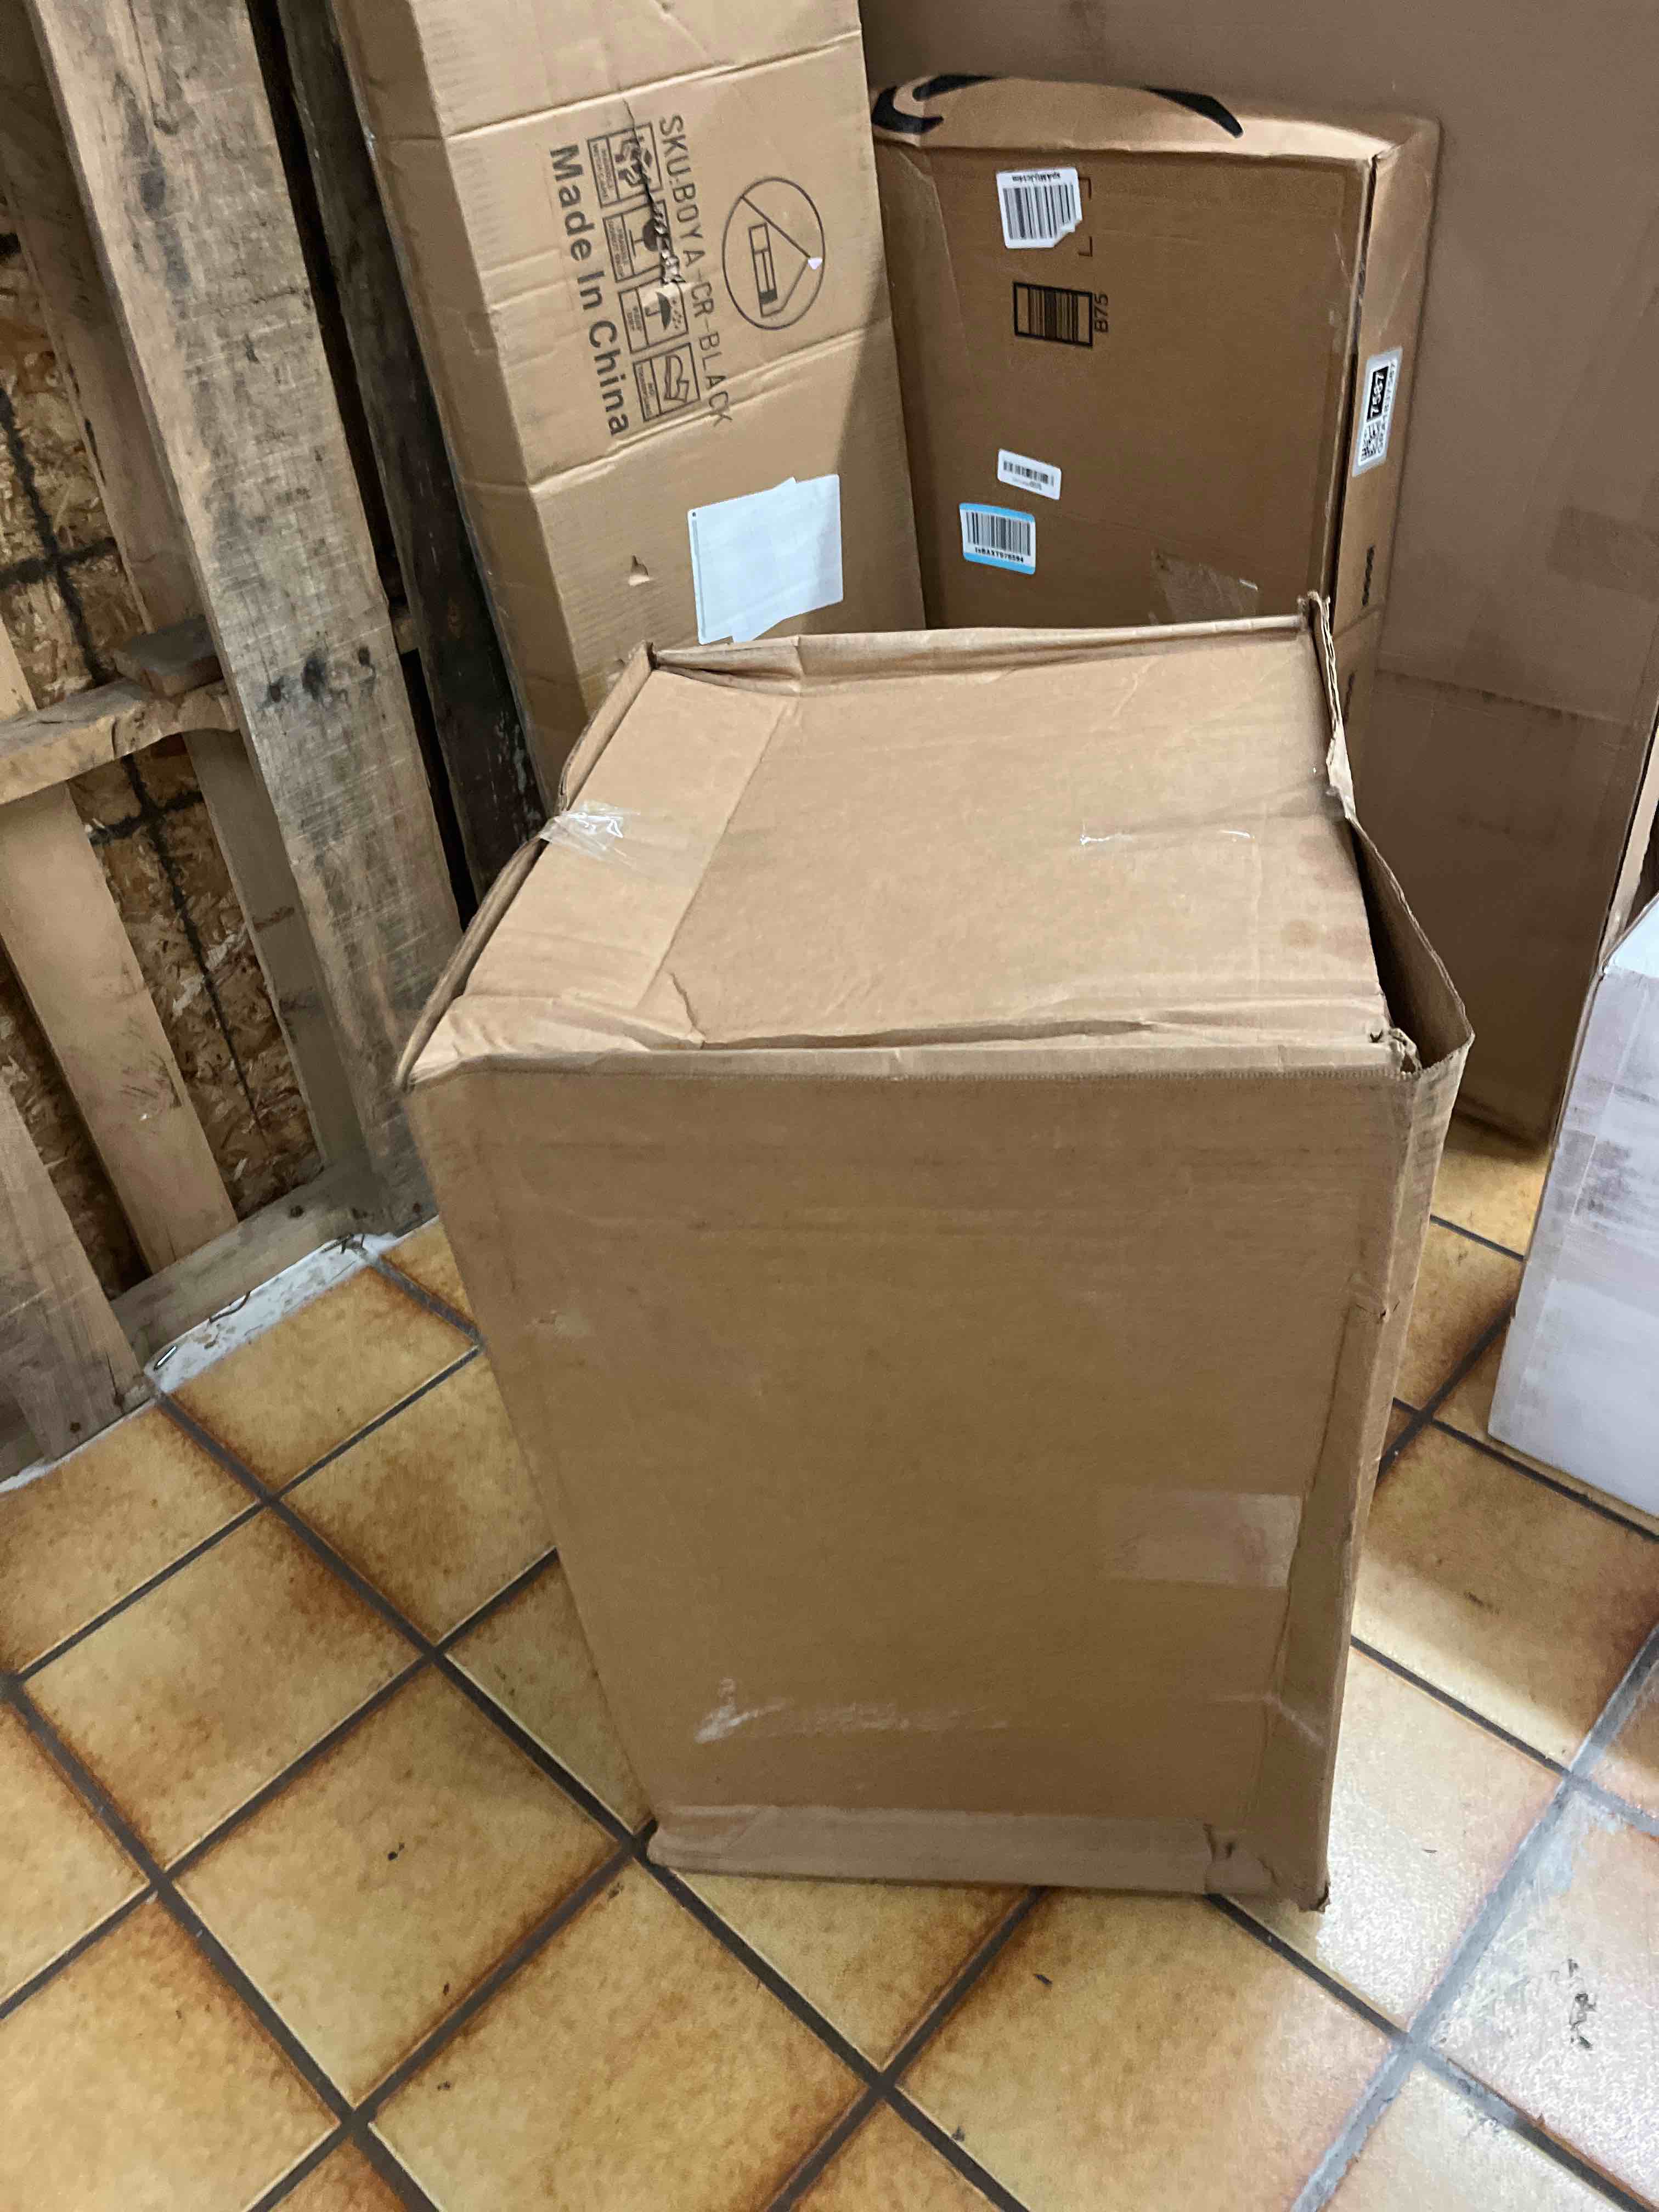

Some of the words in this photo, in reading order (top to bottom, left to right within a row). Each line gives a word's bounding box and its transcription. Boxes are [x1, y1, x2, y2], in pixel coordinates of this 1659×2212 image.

[550, 144, 594, 262] Made
[578, 270, 604, 312] In
[1094, 294, 1108, 333] B75
[589, 320, 629, 436] China
